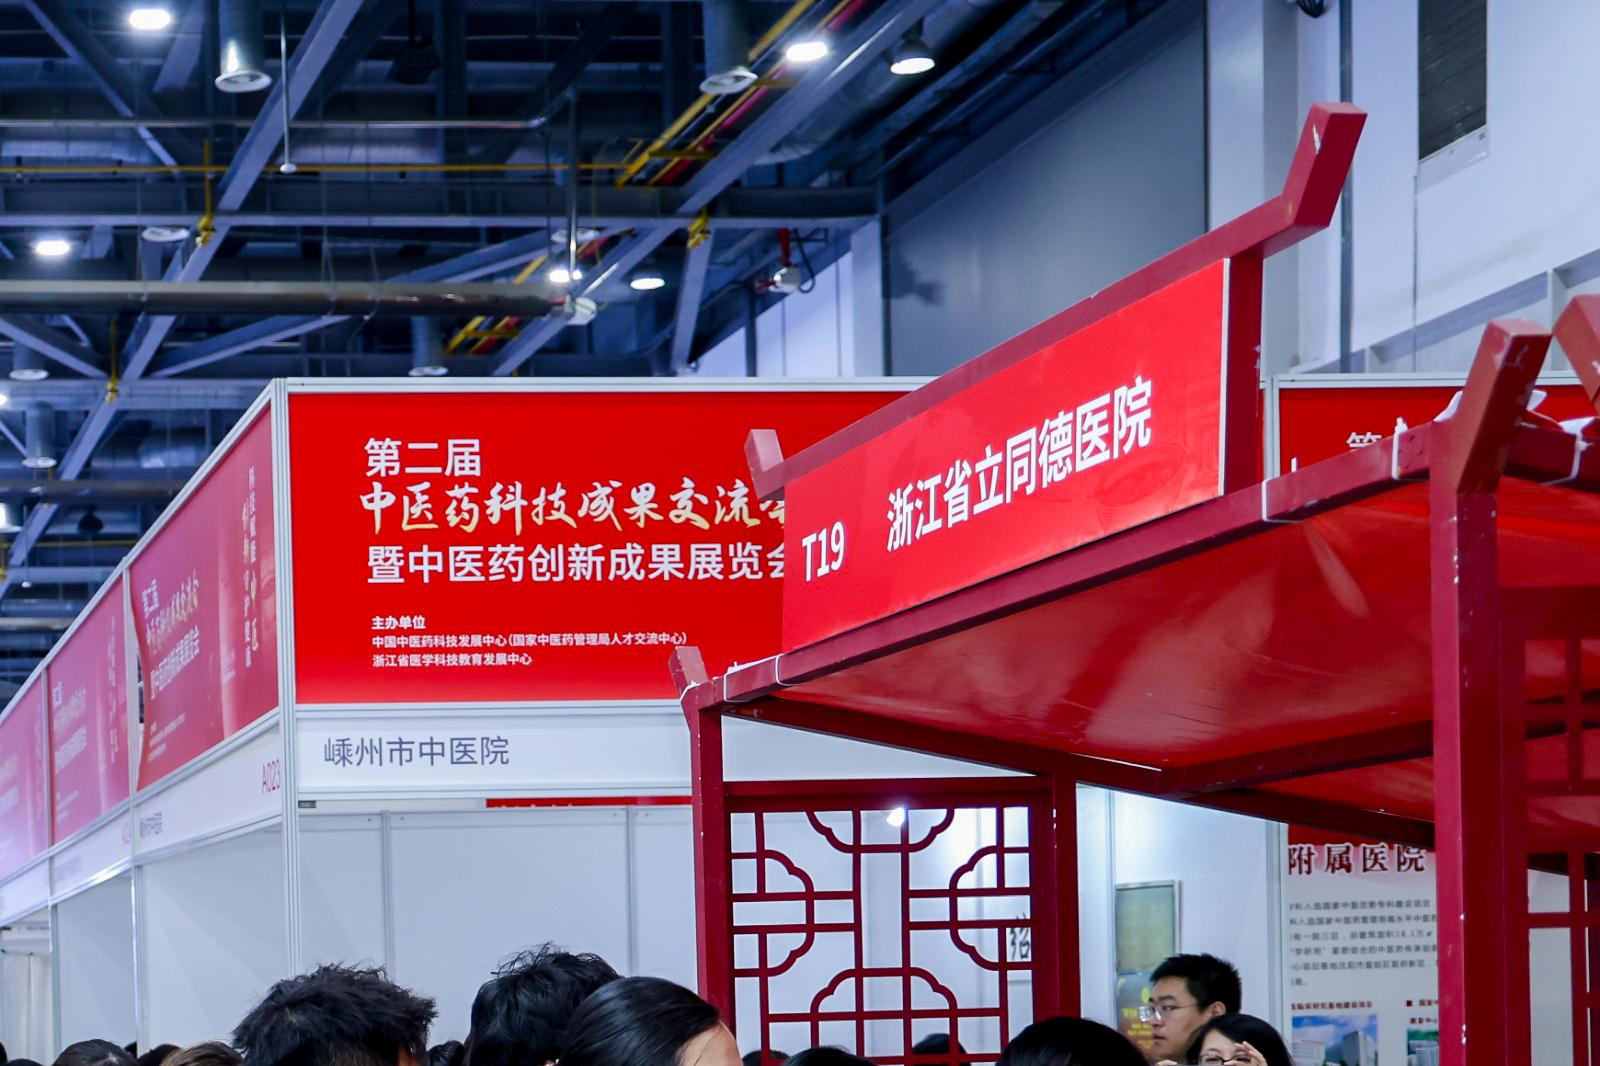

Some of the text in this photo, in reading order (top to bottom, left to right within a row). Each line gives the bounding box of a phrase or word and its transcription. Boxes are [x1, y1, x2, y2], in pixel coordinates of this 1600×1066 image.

[364, 438, 481, 477] 第二届
[801, 375, 1152, 582] T19 浙江省立同德医院
[372, 616, 426, 630] 主办单位
[372, 652, 532, 667] 浙江省医学科技教育发展中心
[324, 736, 509, 767] 嵊州市中医院
[1288, 843, 1425, 876] 附属医院
